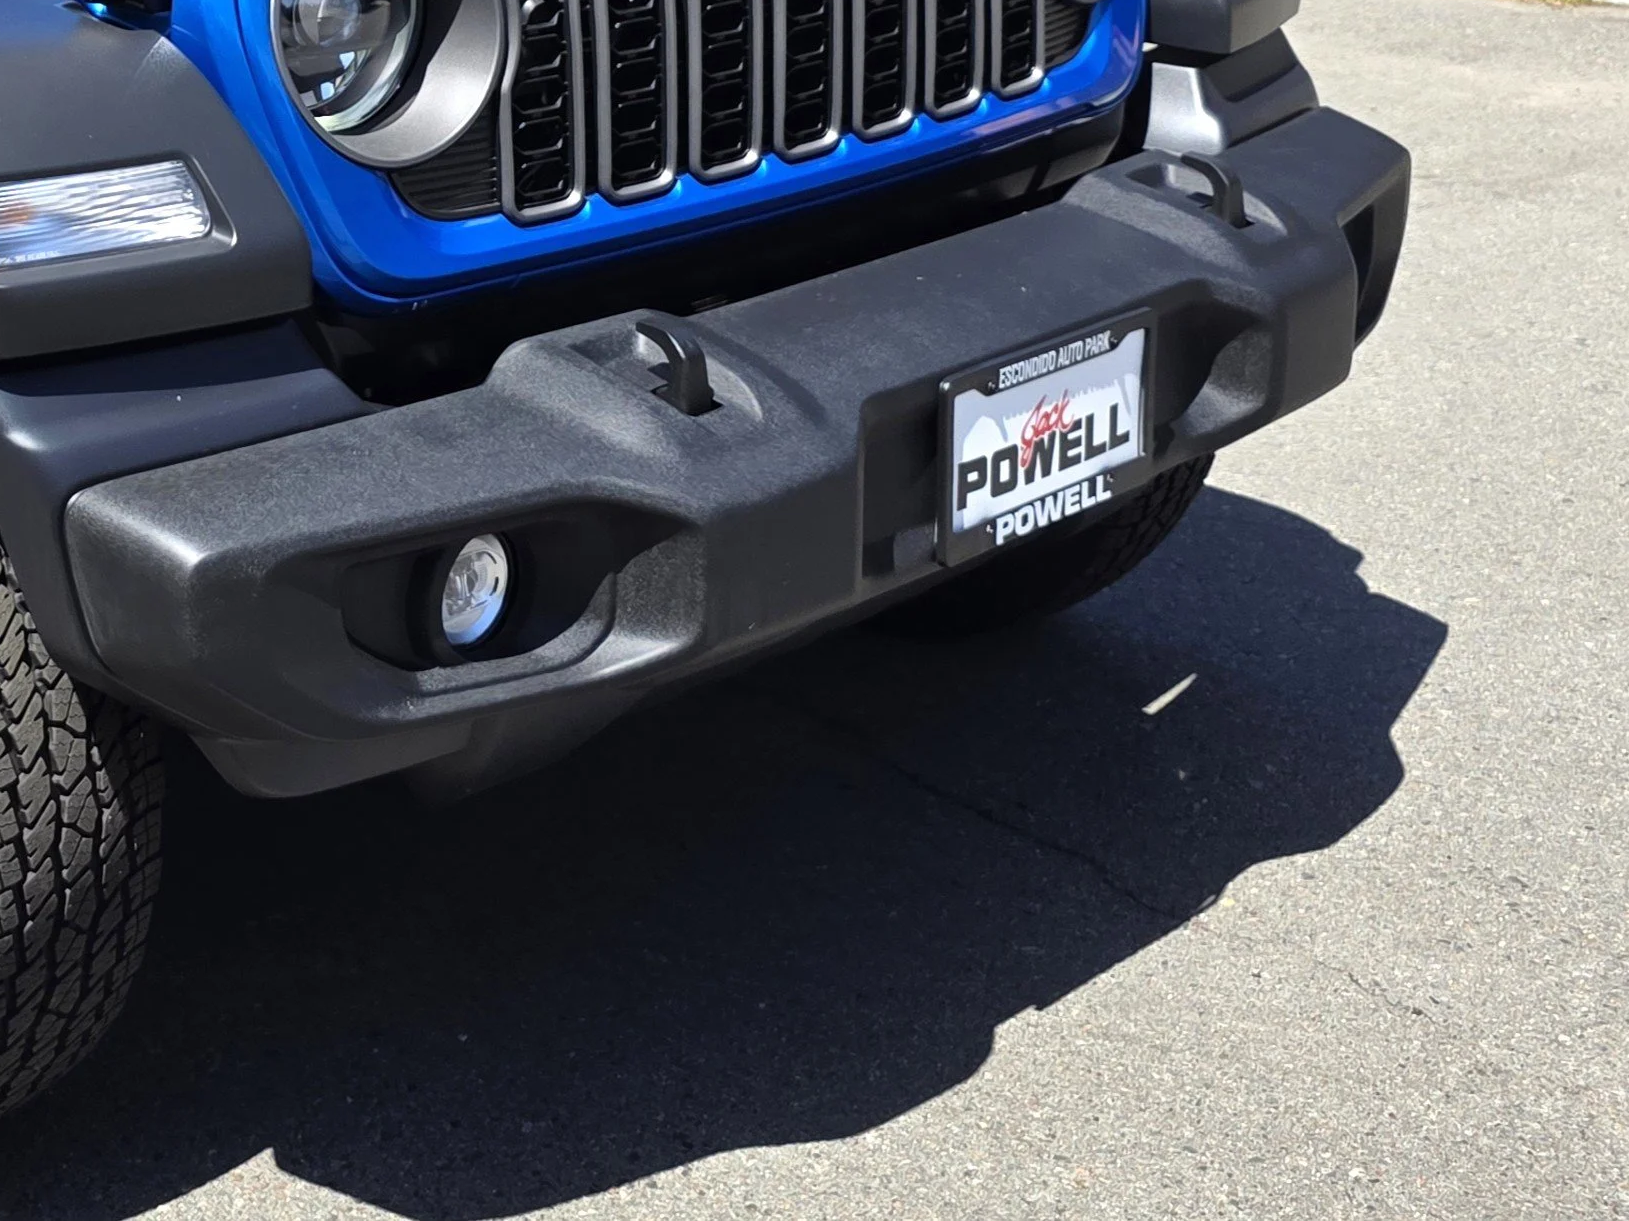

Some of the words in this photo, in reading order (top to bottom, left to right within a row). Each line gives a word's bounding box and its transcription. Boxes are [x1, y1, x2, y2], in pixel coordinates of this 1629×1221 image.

[998, 350, 1057, 389] ESCONDIDO
[1057, 340, 1084, 367] AUTO
[1085, 330, 1111, 356] PARK
[956, 402, 1130, 512] POWELL
[1020, 388, 1074, 467] Jack
[995, 474, 1113, 546] POWELL
